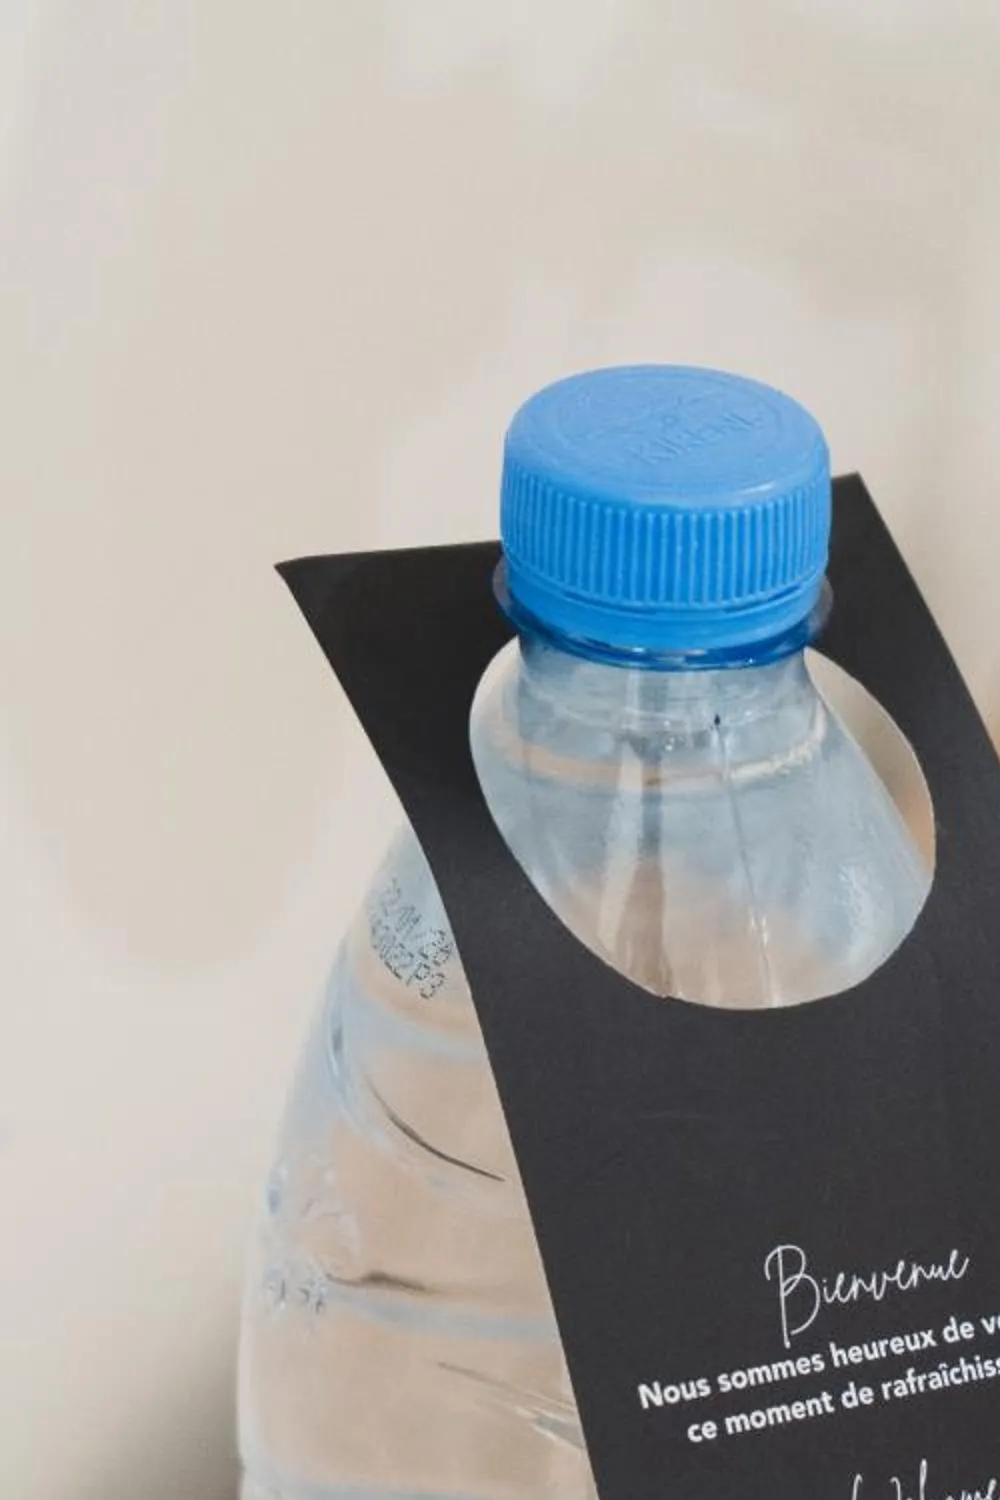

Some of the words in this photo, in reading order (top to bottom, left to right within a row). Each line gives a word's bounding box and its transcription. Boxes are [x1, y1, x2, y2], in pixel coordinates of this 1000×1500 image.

[763, 1244, 970, 1349] Bienvenue
[638, 1378, 712, 1410] Nous
[716, 1353, 826, 1393] sommes
[829, 1329, 938, 1368] heureux
[942, 1316, 975, 1344] de
[687, 1420, 718, 1443] ce
[724, 1391, 836, 1435] moment
[840, 1381, 875, 1409] de
